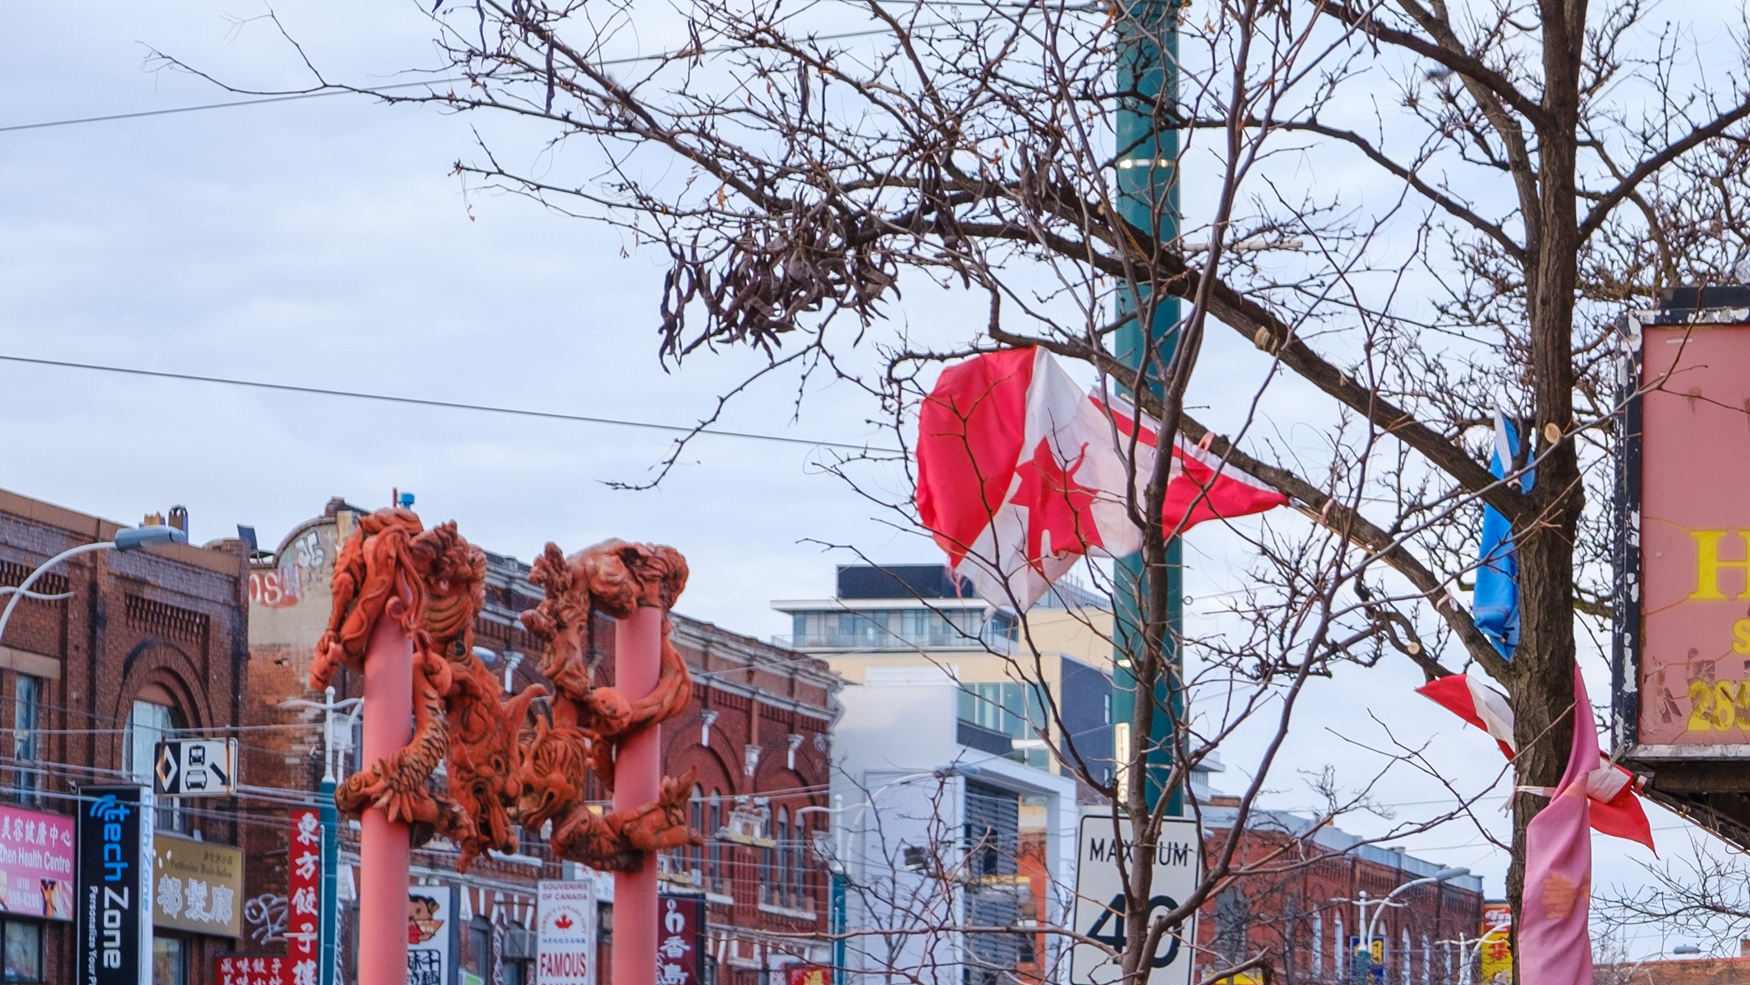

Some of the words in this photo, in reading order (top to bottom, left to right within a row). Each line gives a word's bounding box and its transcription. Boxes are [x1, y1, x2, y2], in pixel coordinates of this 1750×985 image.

[19, 847, 43, 870] Health
[44, 851, 71, 874] Centre
[1089, 837, 1189, 867] MAXUM
[542, 883, 588, 891] SOUVENIRS
[555, 893, 587, 901] CANADA
[89, 885, 98, 945] Personalize
[103, 886, 129, 969] Zone
[1086, 893, 1182, 968] 40
[540, 952, 586, 977] FAMOUS
